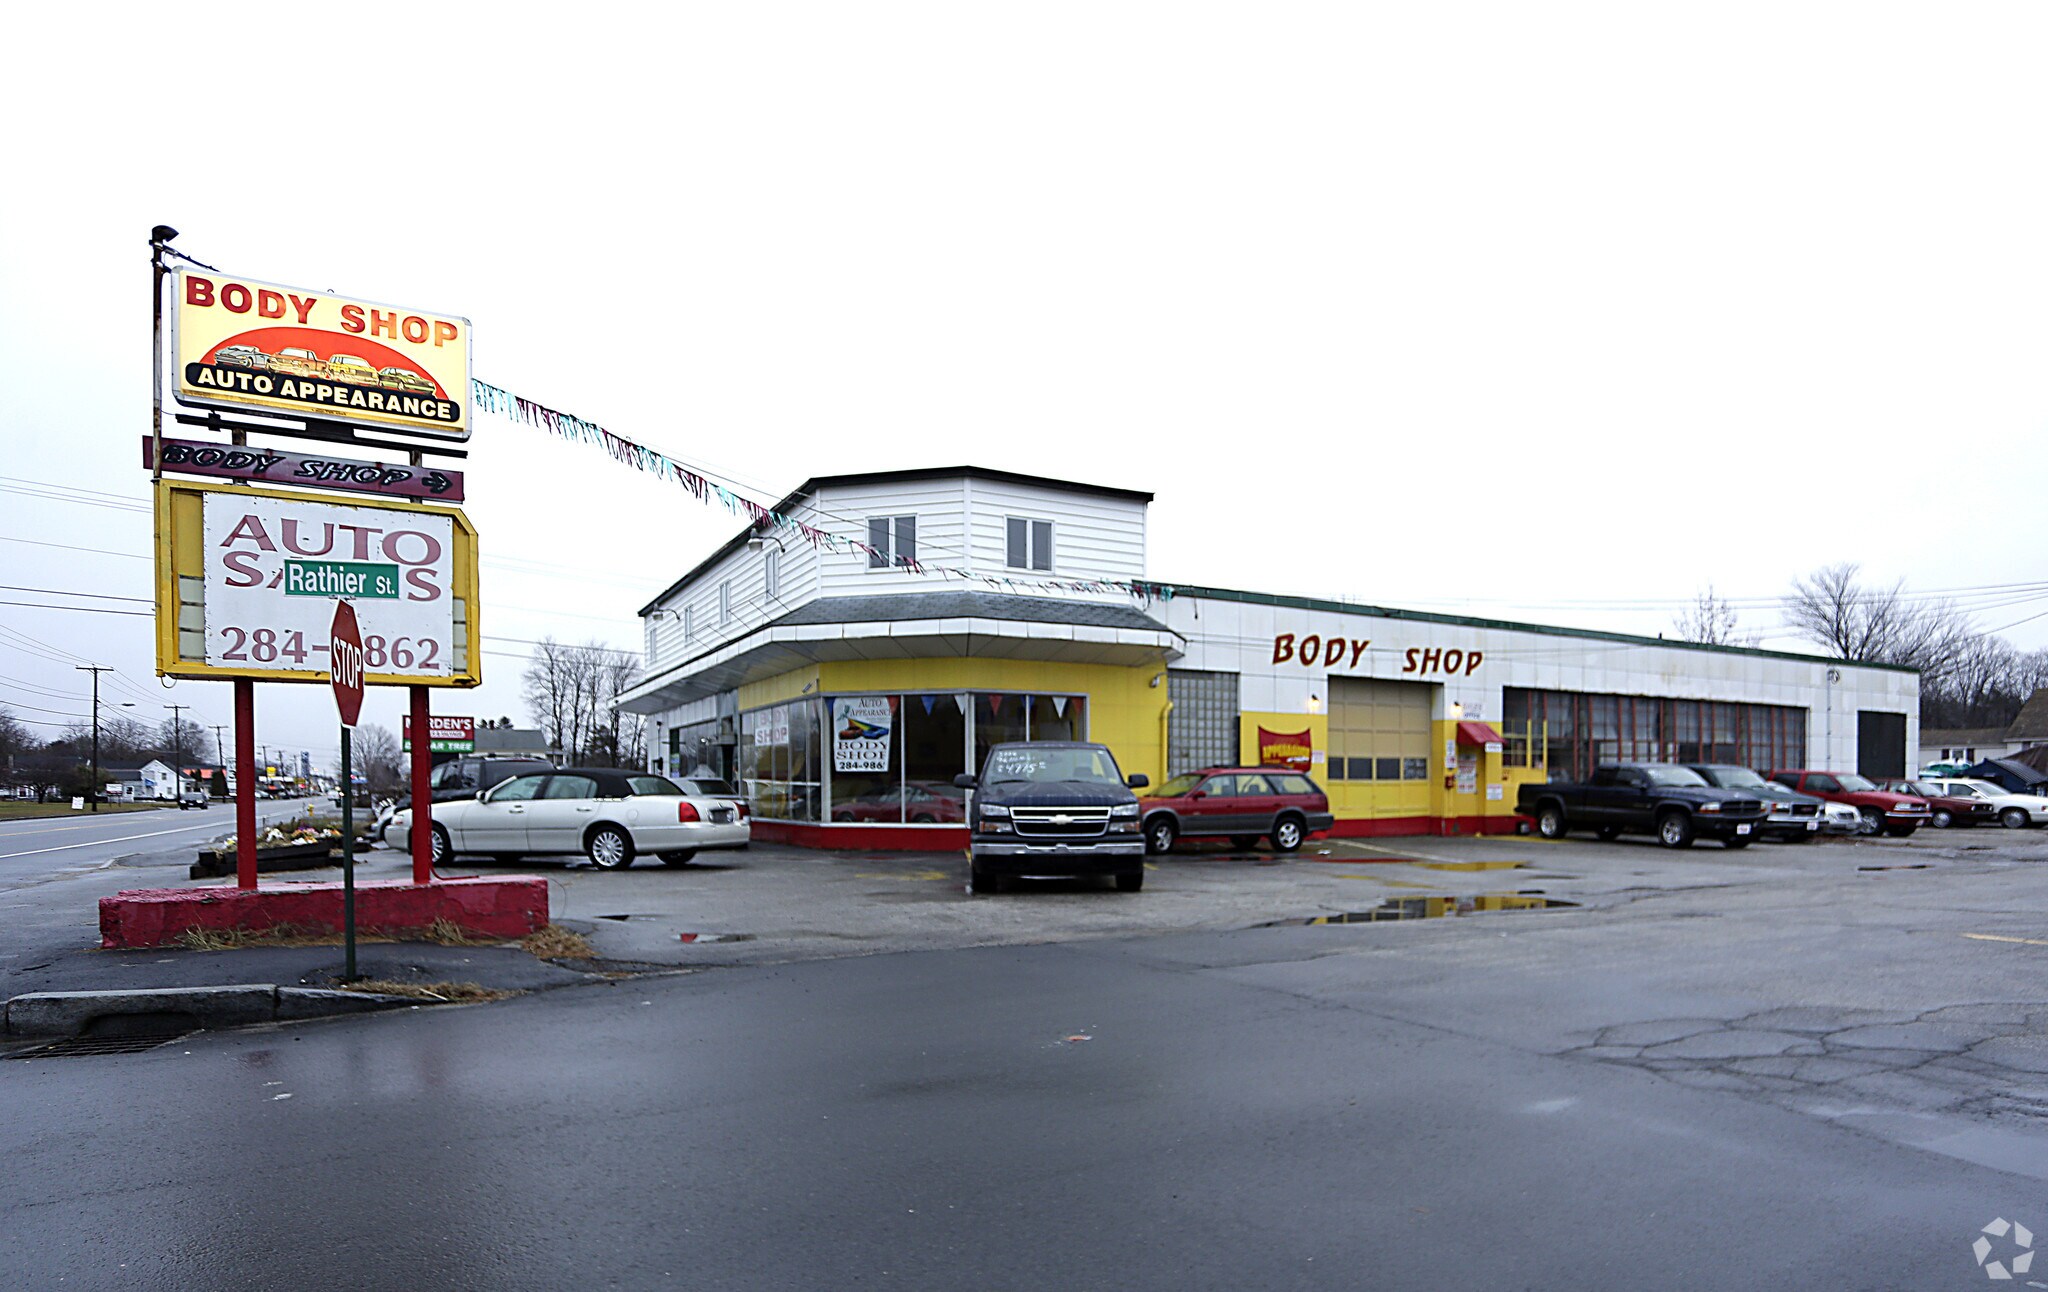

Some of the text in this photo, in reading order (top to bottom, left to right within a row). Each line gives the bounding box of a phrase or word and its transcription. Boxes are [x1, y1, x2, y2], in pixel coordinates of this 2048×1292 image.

[186, 275, 458, 347] BODY SHOP
[197, 367, 452, 420] AUTO APPEARANCE
[161, 444, 413, 487] BODY SHOP
[219, 514, 442, 566] AUTO
[289, 564, 368, 593] Rathier
[376, 576, 395, 595] St.
[220, 627, 440, 670] 284-862
[333, 636, 362, 690] STOP
[1272, 633, 1484, 676] BODY SHOP
[858, 698, 882, 708] AUTO
[839, 742, 887, 750] BODY
